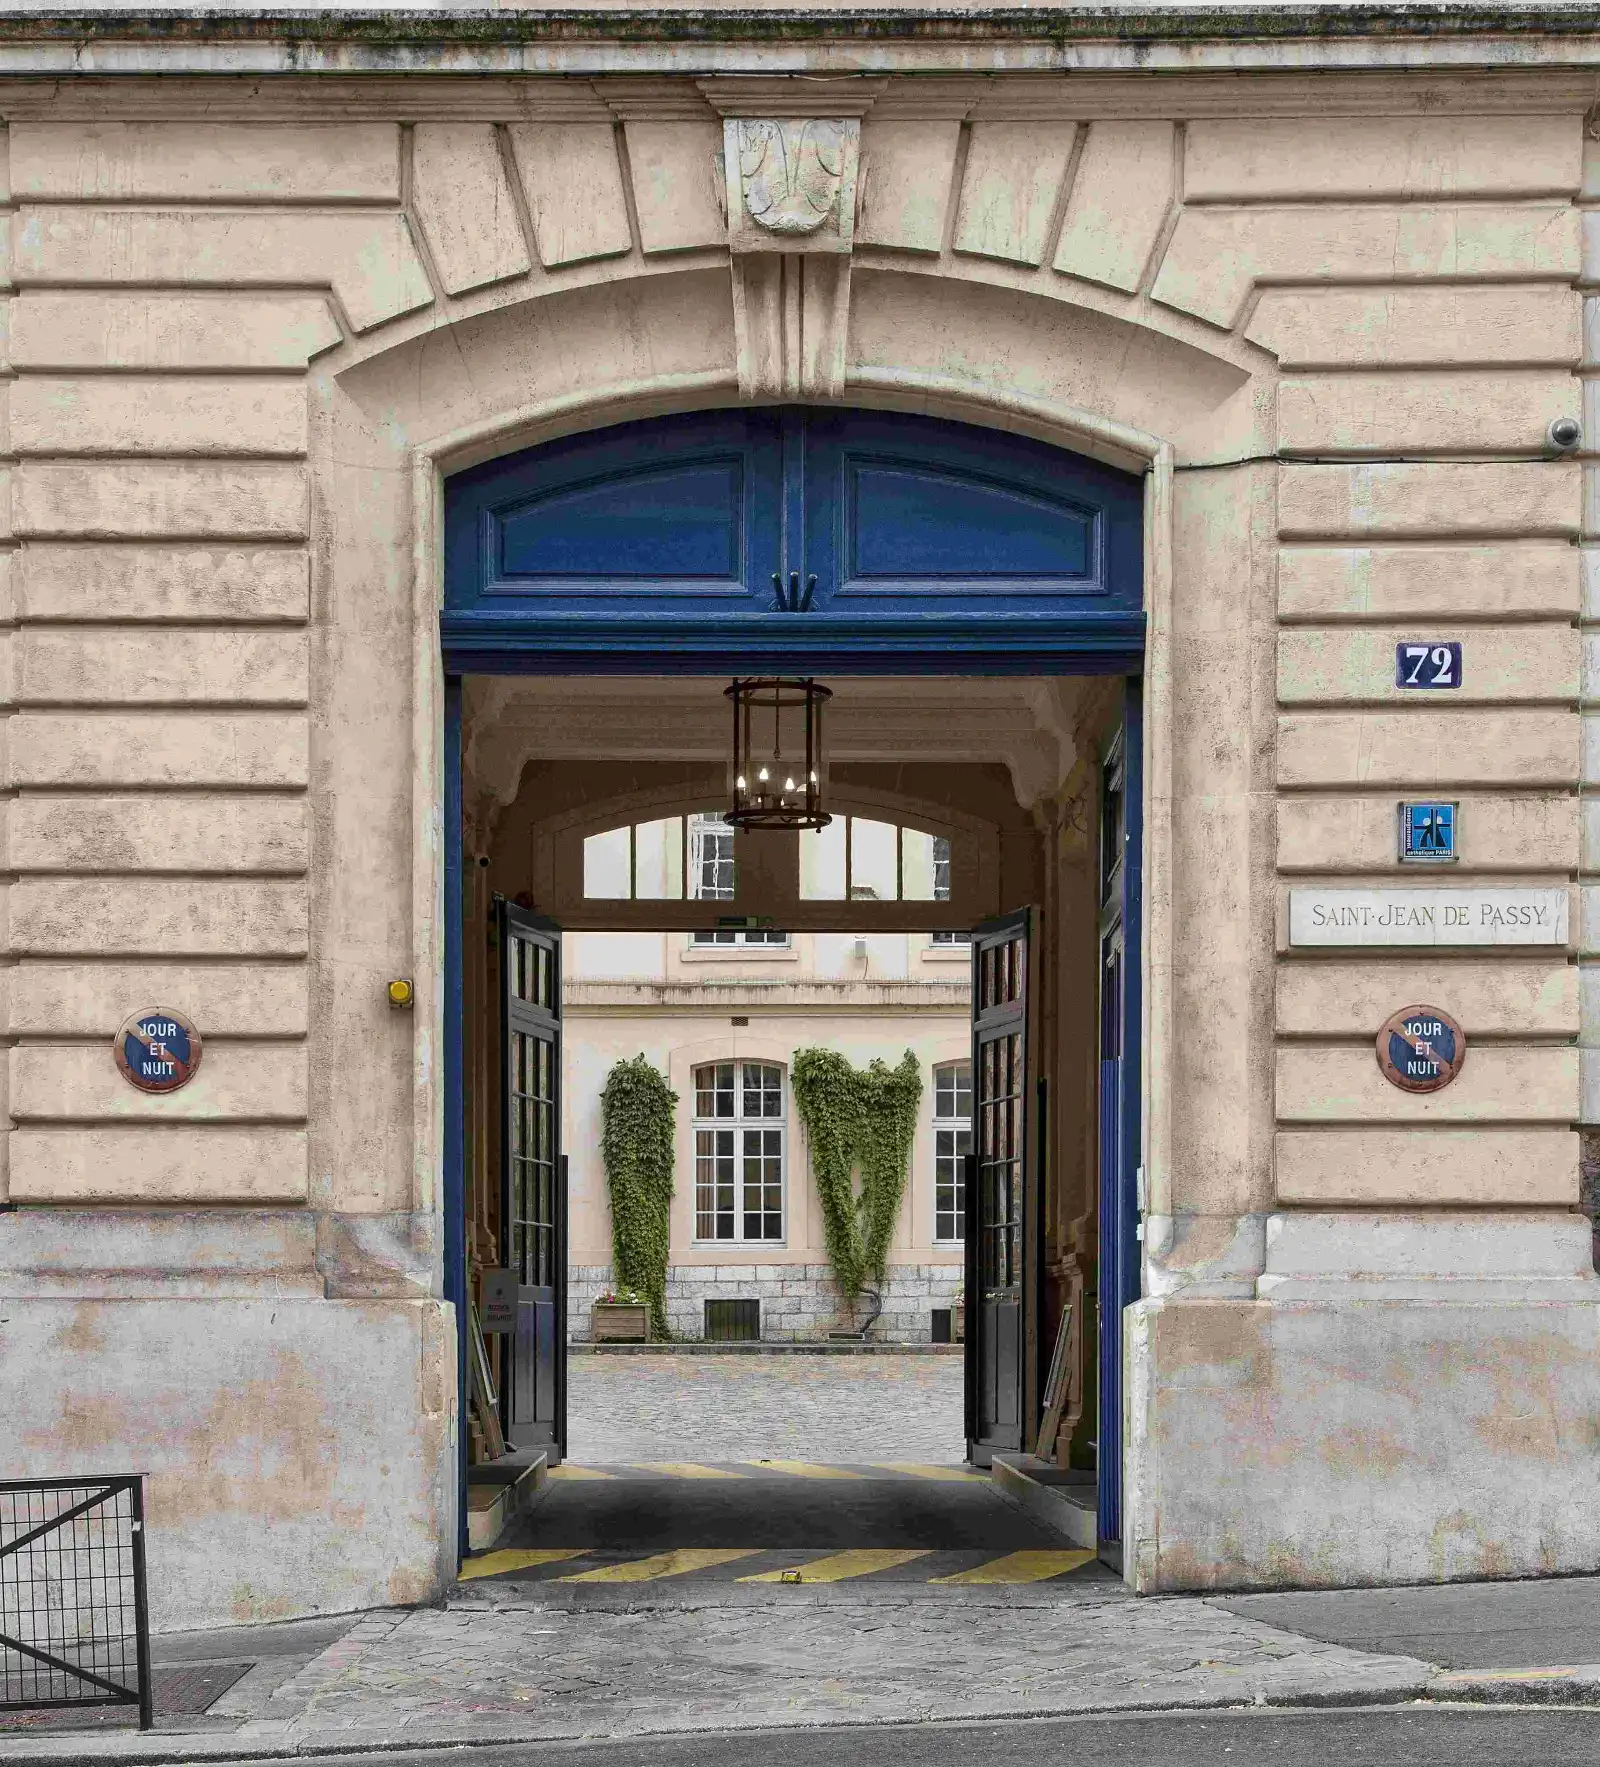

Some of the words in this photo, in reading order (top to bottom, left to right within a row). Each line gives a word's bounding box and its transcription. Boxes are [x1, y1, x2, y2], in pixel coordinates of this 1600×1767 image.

[1405, 647, 1452, 684] 72
[1443, 906, 1470, 926] DE
[1480, 904, 1548, 926] PASSY
[139, 1023, 177, 1037] JOUR
[1404, 1022, 1442, 1036] JOUR
[149, 1042, 167, 1056] ET
[1415, 1041, 1432, 1055] ET
[143, 1061, 175, 1075] NUIT
[1407, 1061, 1440, 1075] NUIT
